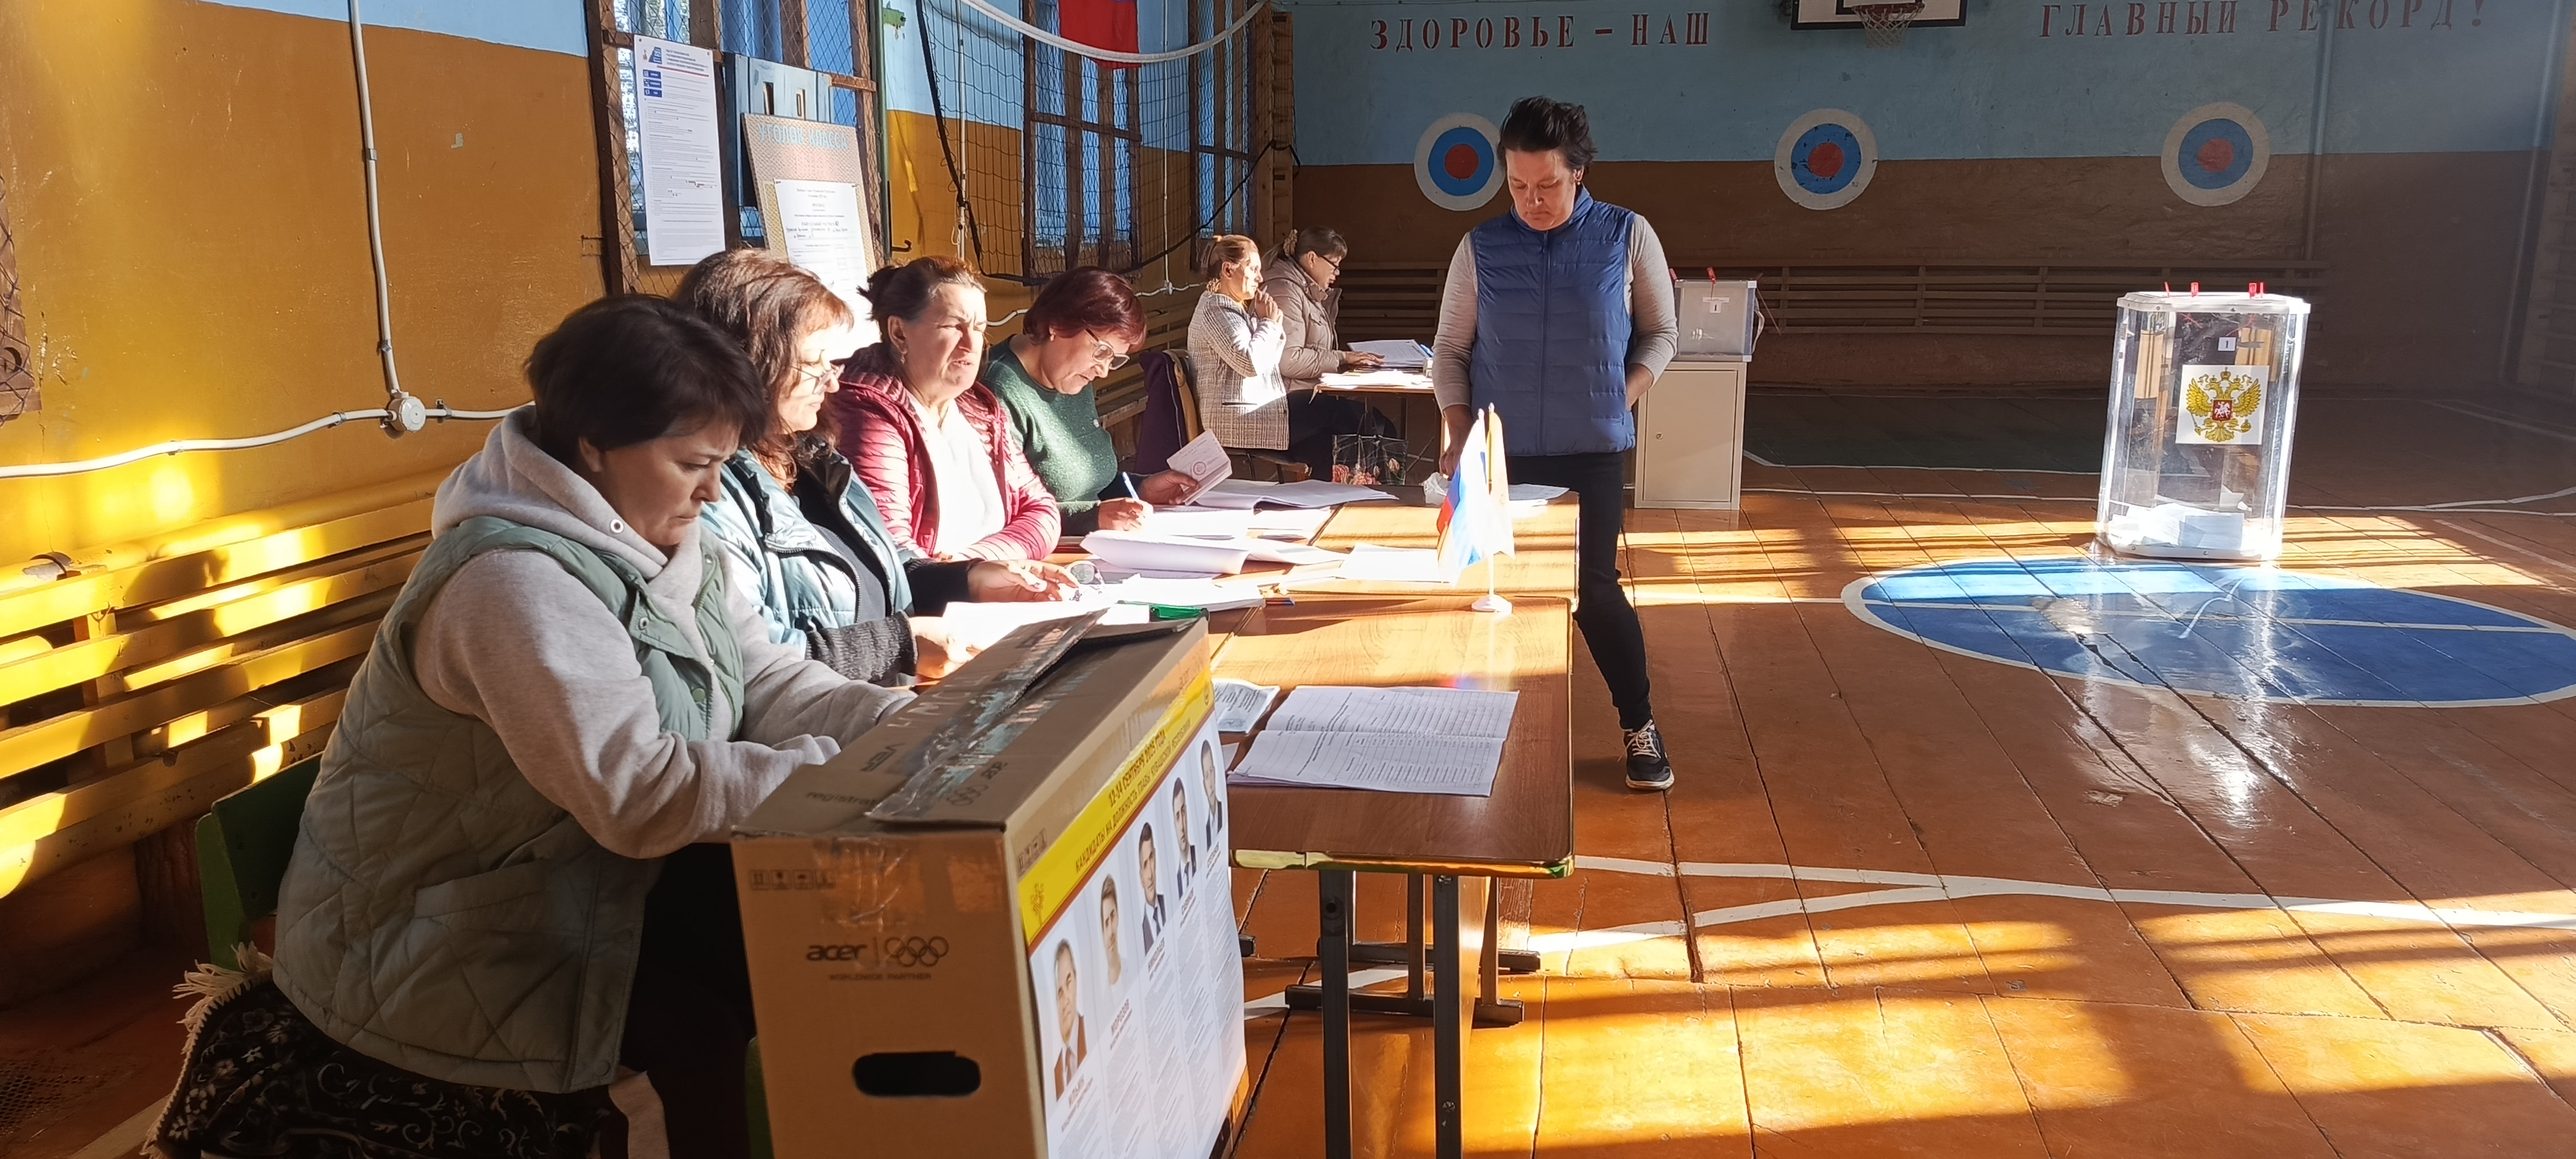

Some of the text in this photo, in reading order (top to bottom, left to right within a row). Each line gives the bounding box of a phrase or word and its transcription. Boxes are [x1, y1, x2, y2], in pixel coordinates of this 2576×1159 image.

[1370, 15, 1574, 53] ЗДОРОВЬЕ
[1631, 13, 1709, 46] НАШ
[758, 123, 848, 150] УГОЛОК КЛАССА
[2225, 340, 2229, 349] 1
[1109, 728, 1167, 808] 12-14 СЕНТЯБРЯ 2025 ГОДА
[1075, 828, 1106, 873] КАНДИДАТЫ
[1106, 819, 1114, 838] НА
[1113, 789, 1138, 830] ДОЛЖНОСТЬ
[1138, 771, 1151, 795] ГЛАВЫ
[807, 944, 868, 962] acer
